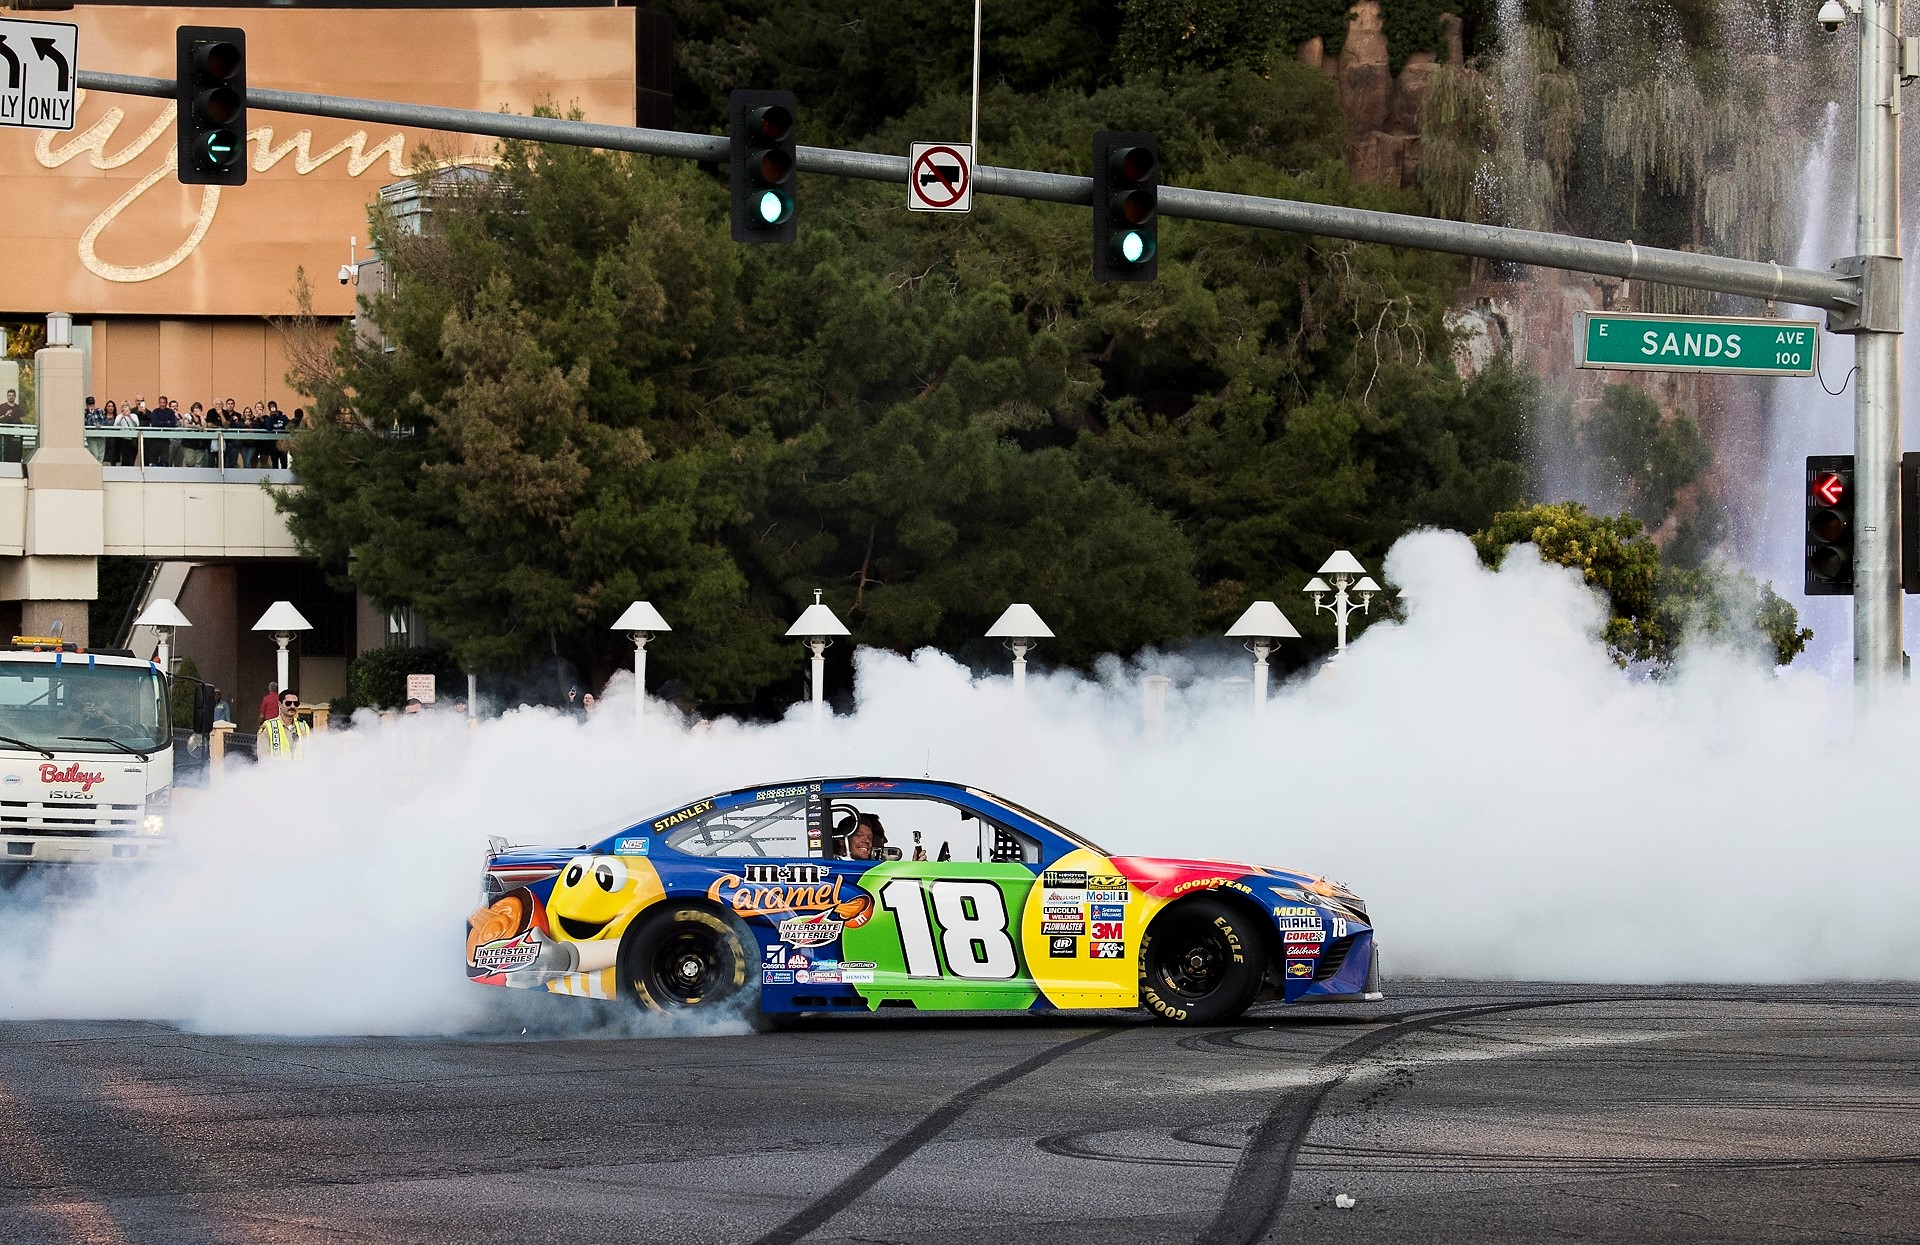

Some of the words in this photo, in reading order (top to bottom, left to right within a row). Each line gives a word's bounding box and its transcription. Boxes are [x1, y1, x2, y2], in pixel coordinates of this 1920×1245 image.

[0, 95, 19, 118] LY
[28, 96, 71, 121] ONLY
[1600, 324, 1608, 337] E
[1641, 331, 1742, 359] SANDS
[1775, 332, 1805, 345] AVE
[1775, 352, 1801, 365] 100
[39, 763, 105, 791] Baileys
[49, 790, 94, 800] ISUZU
[654, 801, 711, 832] STANLEY
[708, 874, 844, 910] Caramel
[1086, 891, 1116, 901] Mobil
[1273, 907, 1317, 916] MOOG
[781, 922, 840, 932] INTERSTATE
[879, 878, 1020, 980] 18
[1043, 923, 1083, 933] FLOWMASTER
[1280, 918, 1321, 928] MAHLE
[1332, 918, 1347, 937] 18
[784, 931, 835, 940] BATTERIES
[1091, 923, 1123, 939] 3M
[1286, 932, 1316, 940] COMP
[1213, 916, 1244, 964] EAGLE
[478, 946, 536, 957] INTERSTATE
[1286, 946, 1321, 955] Edelbrock
[481, 954, 533, 965] BATTERIES
